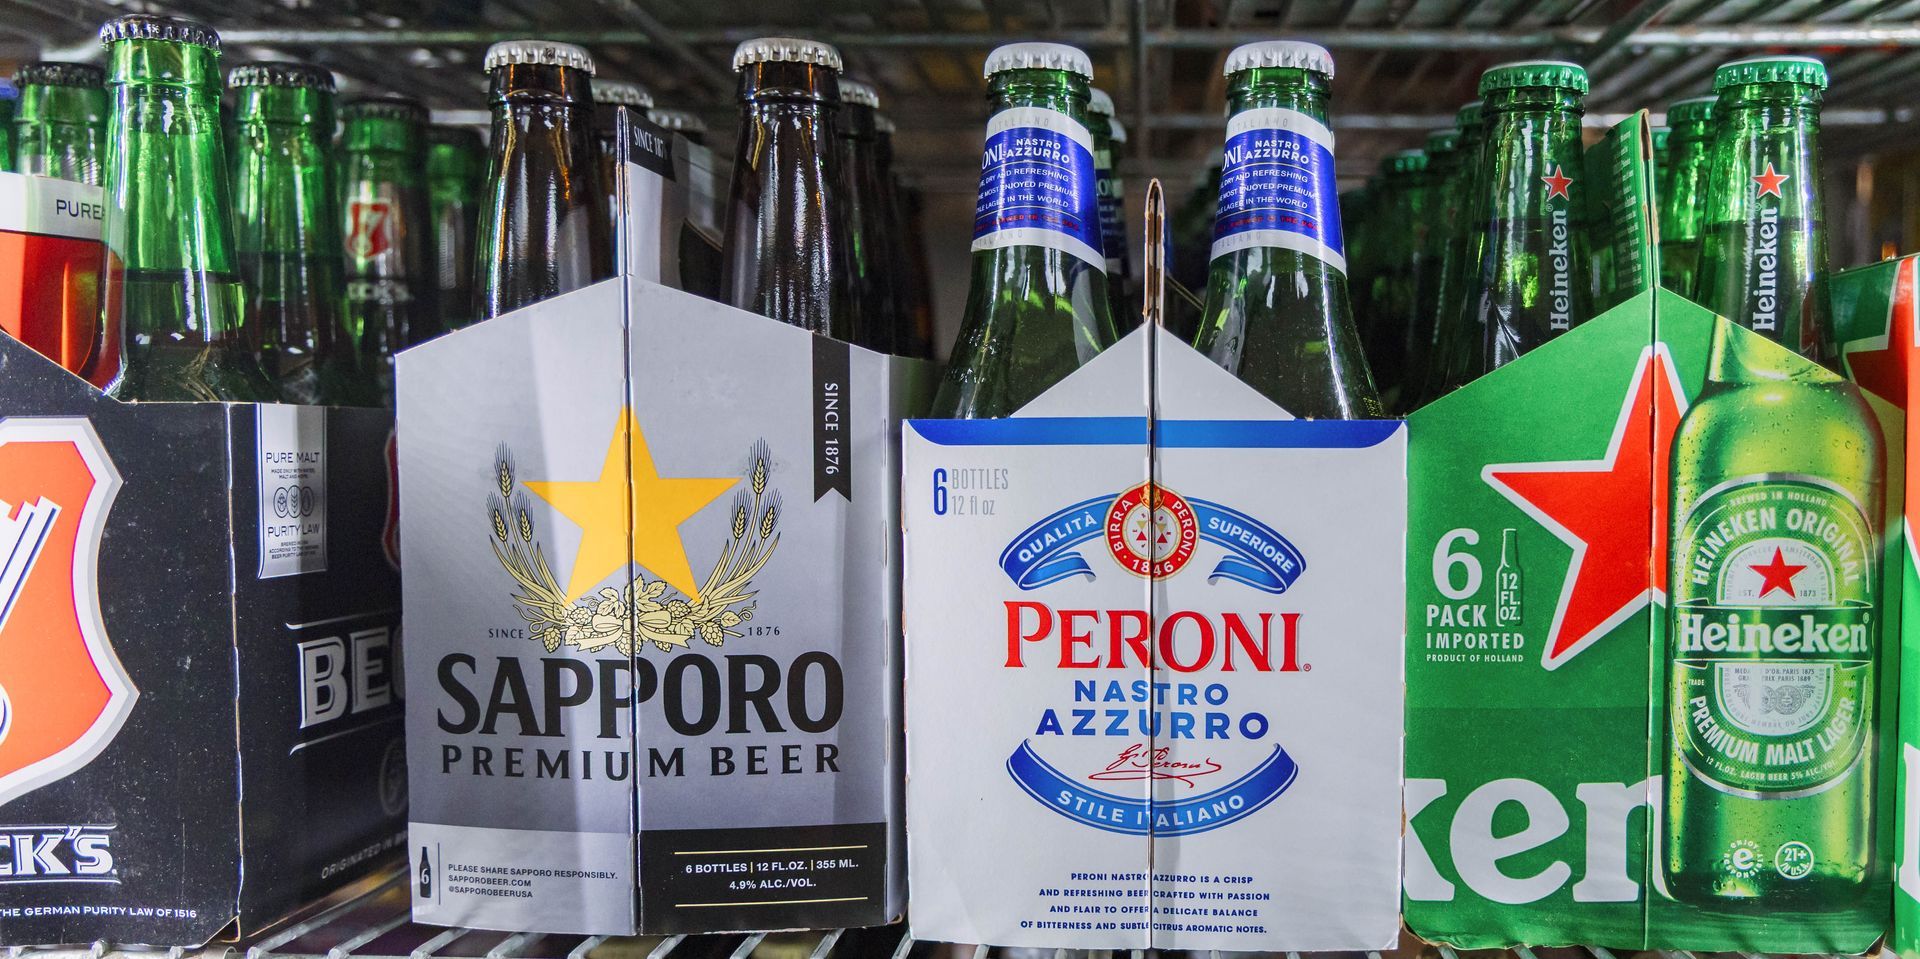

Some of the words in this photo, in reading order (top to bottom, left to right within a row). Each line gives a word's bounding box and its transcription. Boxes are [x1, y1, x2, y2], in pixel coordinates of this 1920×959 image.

[634, 126, 653, 153] SINCE
[654, 137, 667, 160] 187
[1016, 138, 1061, 150] NASTRO
[1255, 140, 1301, 151] NASTRO
[1007, 147, 1071, 164] AZZURRO
[1245, 148, 1310, 165] AZZURRO
[1014, 167, 1069, 183] REFRESHING
[1224, 177, 1235, 187] DRY
[1236, 171, 1251, 182] AND
[1252, 170, 1309, 183] REFRESHING
[1001, 180, 1036, 193] ENJOYED
[1239, 183, 1275, 195] ENJOYED
[1276, 184, 1317, 199] PREMIUM
[56, 199, 102, 220] PURE
[1037, 195, 1069, 208] WORLD
[1223, 199, 1244, 213] LAGER
[1275, 196, 1308, 209] WORLD
[1548, 209, 1570, 331] Heineken
[1752, 206, 1778, 331] Heineken
[824, 382, 839, 431] SINCE
[266, 452, 294, 463] PURE
[296, 452, 320, 463] MALT
[825, 438, 840, 475] 1876
[952, 468, 1009, 490] BOTTLES
[933, 467, 948, 516] 6
[1771, 490, 1783, 499] IN
[1787, 491, 1828, 506] HOLLAND
[952, 495, 965, 516] 12
[970, 495, 978, 516] fl
[982, 499, 995, 516] oz
[268, 525, 300, 537] PURITY
[302, 524, 320, 535] LAW
[1018, 510, 1098, 563] QUALITÀ
[1109, 499, 1134, 552] BIRRA
[1171, 500, 1195, 557] PERONI
[1208, 516, 1296, 575] SUPERIORE
[1692, 507, 1776, 587] HEINEKEN
[1786, 508, 1860, 587] ORIGINAL
[1132, 559, 1174, 576] 1846
[1432, 527, 1483, 601] 6
[1501, 572, 1518, 590] 12
[1500, 591, 1521, 606] FL.
[1800, 589, 1817, 597] 1873
[1426, 604, 1487, 627] PACK
[1500, 606, 1521, 621] OZ.
[488, 628, 524, 640] SINCE
[748, 625, 781, 637] 1876
[1003, 599, 1302, 673] PERONI
[1679, 612, 1868, 654] Heineken
[1426, 632, 1525, 650] IMPORTED
[1426, 653, 1466, 662] PRODUCT
[1469, 653, 1481, 662] OF
[1484, 653, 1524, 663] HOLLAND
[298, 624, 404, 730] BE
[437, 650, 844, 739] SAPPORO
[1074, 679, 1229, 706] NASTRO
[1035, 708, 1269, 740] AZZURRO
[1689, 694, 1760, 765] PREMIUM
[1765, 737, 1816, 766] MALT
[1815, 696, 1856, 753] LAGER
[441, 744, 686, 782] PREMIUM
[710, 743, 841, 777] BEER
[1705, 755, 1714, 765] 12
[1741, 771, 1766, 781] LAGER
[1768, 773, 1789, 781] BEER
[1791, 771, 1803, 780] 5%
[1057, 790, 1124, 824] STILE
[321, 842, 381, 879] ORIGINATED
[1784, 847, 1807, 862] 21+
[448, 863, 479, 873] PLEASE
[480, 866, 509, 875] SHARE
[510, 868, 553, 877] SAPPORO
[554, 870, 618, 880] RESPONSIBLY.
[685, 866, 693, 874] 6
[695, 863, 748, 874] BOTTLES
[756, 862, 769, 872] 12
[771, 861, 808, 872] FL.OZ.
[816, 860, 836, 869] 355
[838, 859, 859, 868] ML.
[1780, 862, 1791, 873] IN
[420, 868, 429, 885] 6
[448, 874, 532, 887] SAPPOROBEER.COM
[729, 880, 757, 890] 4.9%
[759, 878, 817, 889] ALC./VOL.
[1071, 873, 1107, 881] PERONI
[1153, 874, 1197, 883] AZZURRO
[1200, 875, 1210, 883] IS
[1223, 876, 1254, 884] CRISP
[448, 886, 533, 898] @SAPPOROBEERUSA
[1039, 888, 1060, 897] AND
[1063, 888, 1123, 897] REFRESHING
[1127, 889, 1149, 897] BEER
[1153, 890, 1196, 900] CRAFTED
[1199, 891, 1224, 901] WITH
[1227, 892, 1271, 901] PASSION
[24, 906, 81, 916] GERMAN
[84, 906, 127, 916] PURITY
[130, 907, 154, 916] LAW
[156, 908, 172, 917] OF
[174, 909, 197, 918] 1516
[1049, 905, 1071, 913] AND
[1074, 905, 1101, 914] FLAIR
[1104, 905, 1117, 914] TO
[1121, 905, 1149, 914] OFFER
[1163, 907, 1209, 916] DELICATE
[1212, 908, 1259, 917] BALANCE
[1020, 920, 1034, 929] OF
[1036, 921, 1093, 930] BITTERNESS
[1095, 921, 1117, 930] AND
[1120, 921, 1149, 930] SUBTLE
[1153, 922, 1184, 932] CITRUS
[1186, 923, 1234, 933] AROMATIC
[1236, 924, 1267, 934] NOTES.
